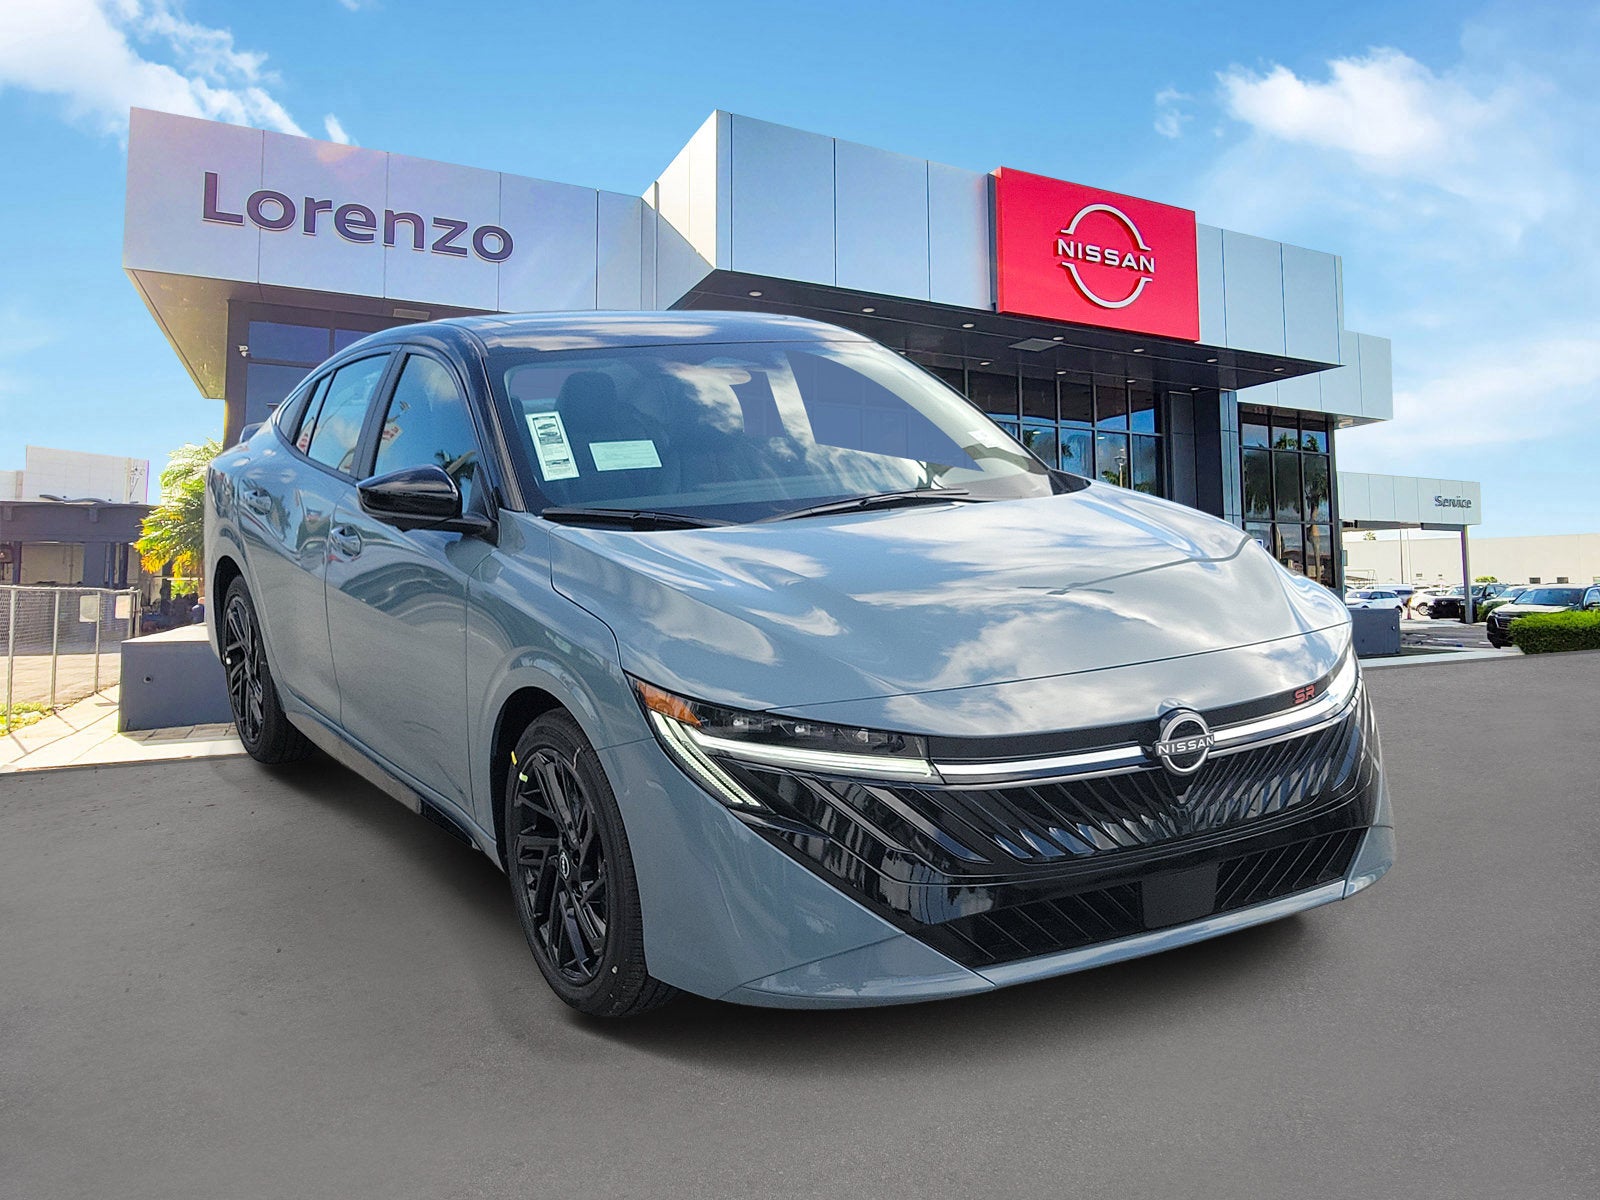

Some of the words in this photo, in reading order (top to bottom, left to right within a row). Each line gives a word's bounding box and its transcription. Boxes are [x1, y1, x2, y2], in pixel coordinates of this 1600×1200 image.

[203, 171, 515, 263] Lorenzo
[1057, 238, 1155, 273] NISSAN
[1434, 495, 1472, 509] Service
[1295, 684, 1316, 704] SR
[1157, 735, 1215, 755] NISSAN
